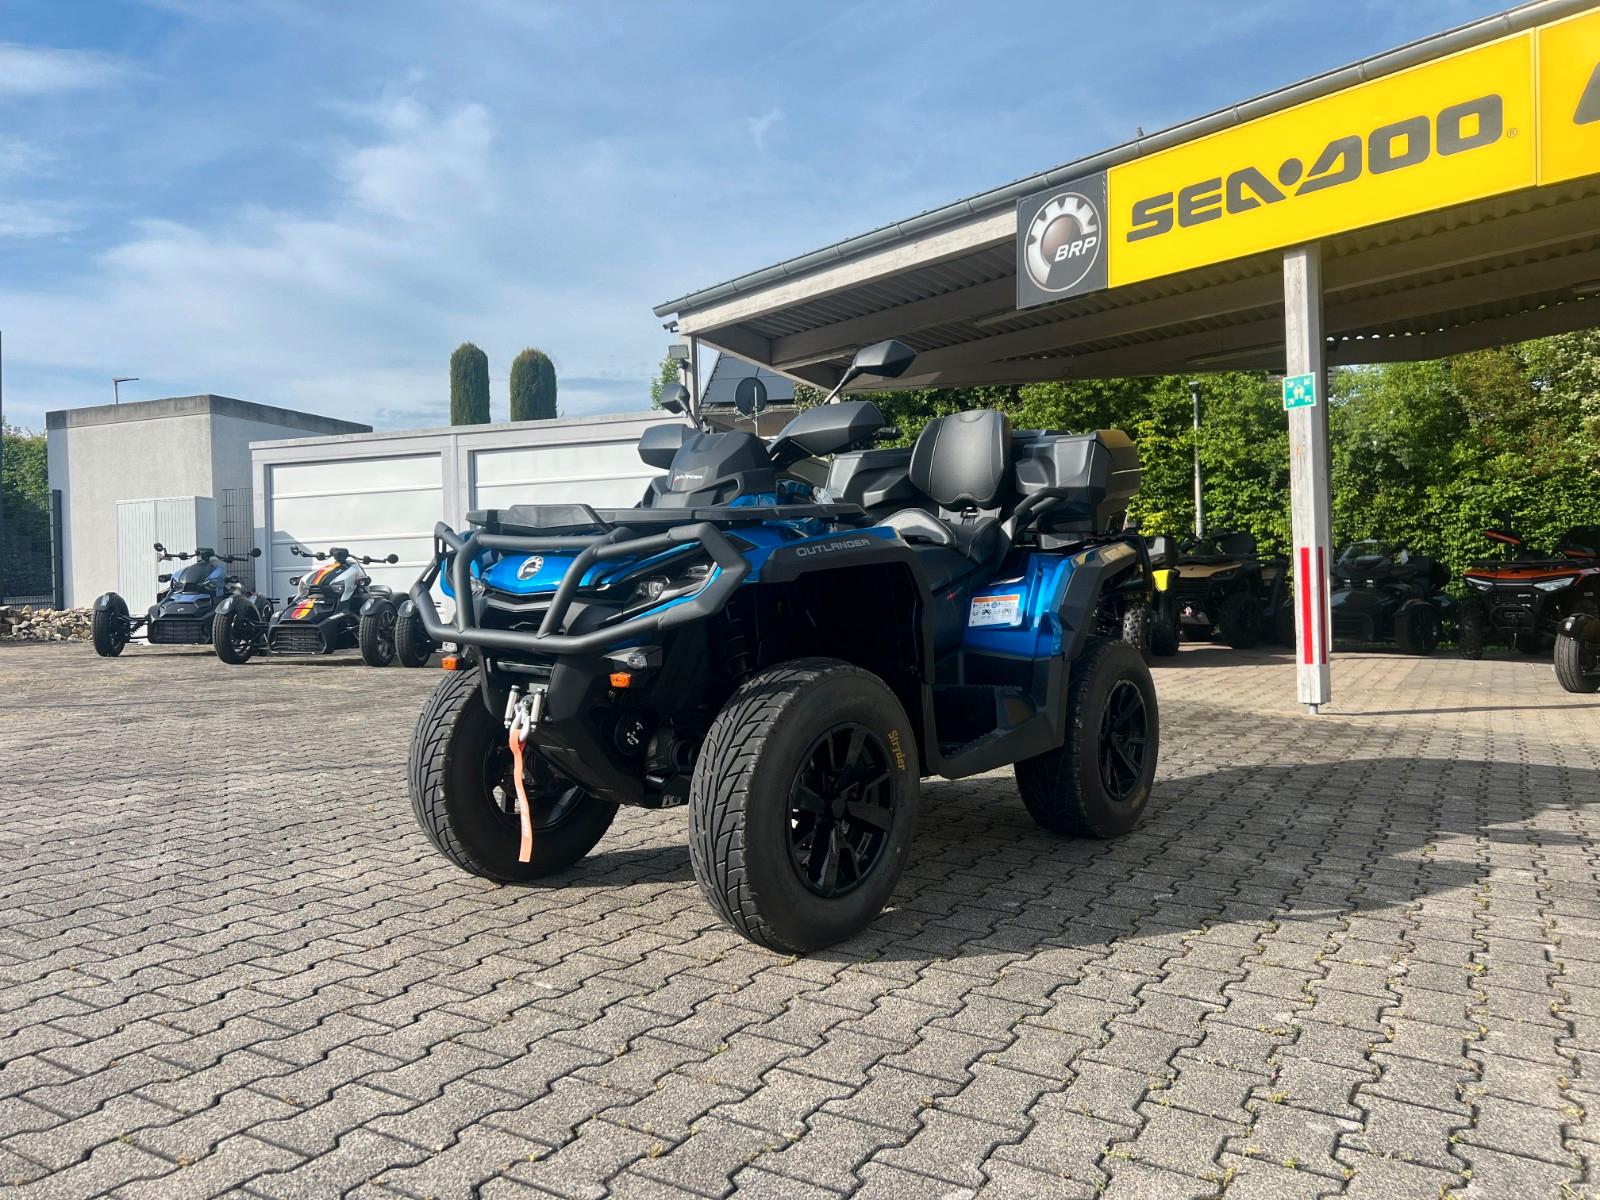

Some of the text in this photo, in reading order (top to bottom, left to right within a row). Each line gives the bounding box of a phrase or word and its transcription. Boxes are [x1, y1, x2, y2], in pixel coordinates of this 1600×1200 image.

[1054, 236, 1097, 263] BRP
[795, 538, 871, 557] OUTLANDER
[888, 730, 906, 770] Stryder
